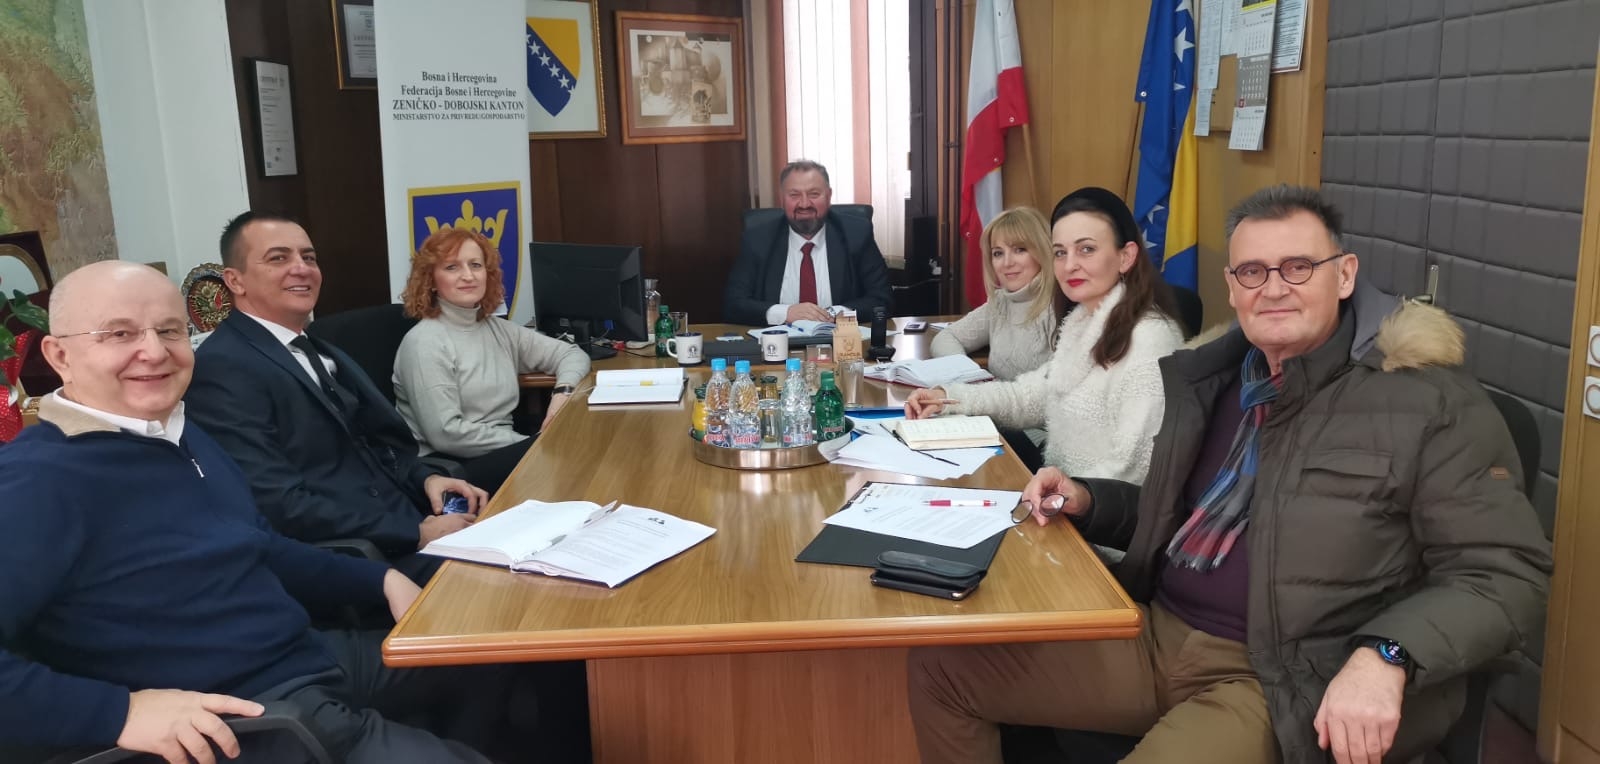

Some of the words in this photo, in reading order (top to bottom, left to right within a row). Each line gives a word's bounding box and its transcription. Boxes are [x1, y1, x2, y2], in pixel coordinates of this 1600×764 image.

[422, 71, 445, 82] Bosna
[447, 72, 451, 82] i
[452, 72, 497, 84] Hercegovina
[401, 85, 443, 97] Federacija
[445, 87, 467, 96] Bosne
[468, 87, 472, 96] i
[473, 87, 517, 98] Hercegovine
[392, 97, 436, 110] ZENIČKO
[444, 100, 487, 110] DOBOJSKI
[489, 100, 524, 110] KANTON
